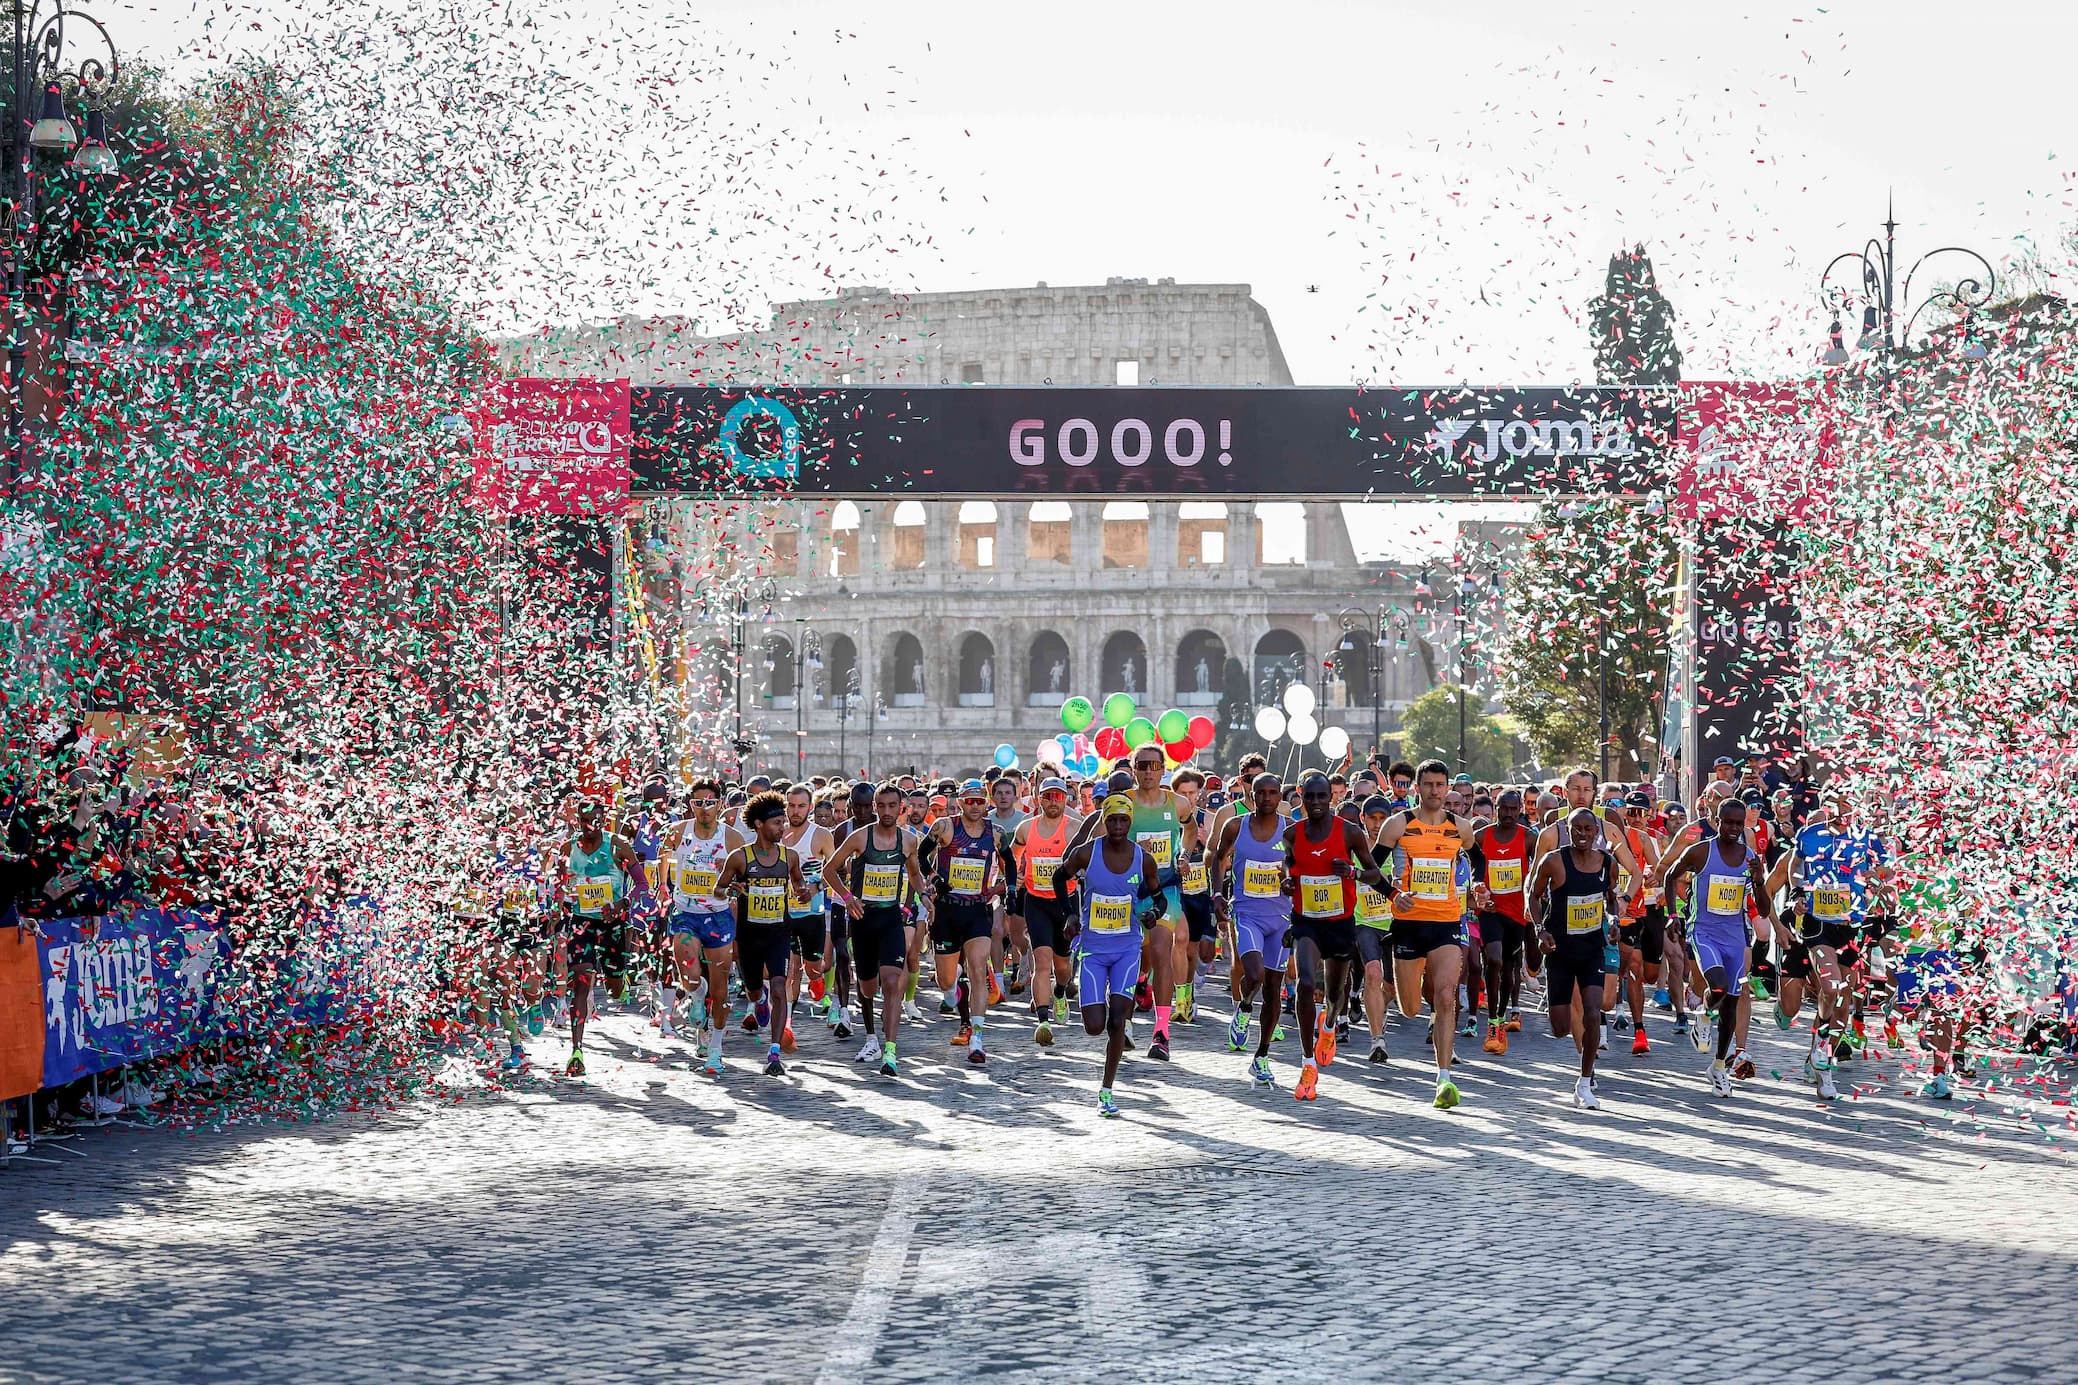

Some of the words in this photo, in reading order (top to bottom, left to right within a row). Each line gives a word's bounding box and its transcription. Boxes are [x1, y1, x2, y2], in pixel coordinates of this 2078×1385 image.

[1009, 418, 1233, 466] GOOO!
[685, 873, 712, 887] DANIELE
[1248, 871, 1277, 885] ANDREW
[1413, 870, 1449, 885] LIBERATORE
[1314, 889, 1329, 902] BOR
[1819, 892, 1846, 905] 1903
[753, 896, 781, 911] PACE
